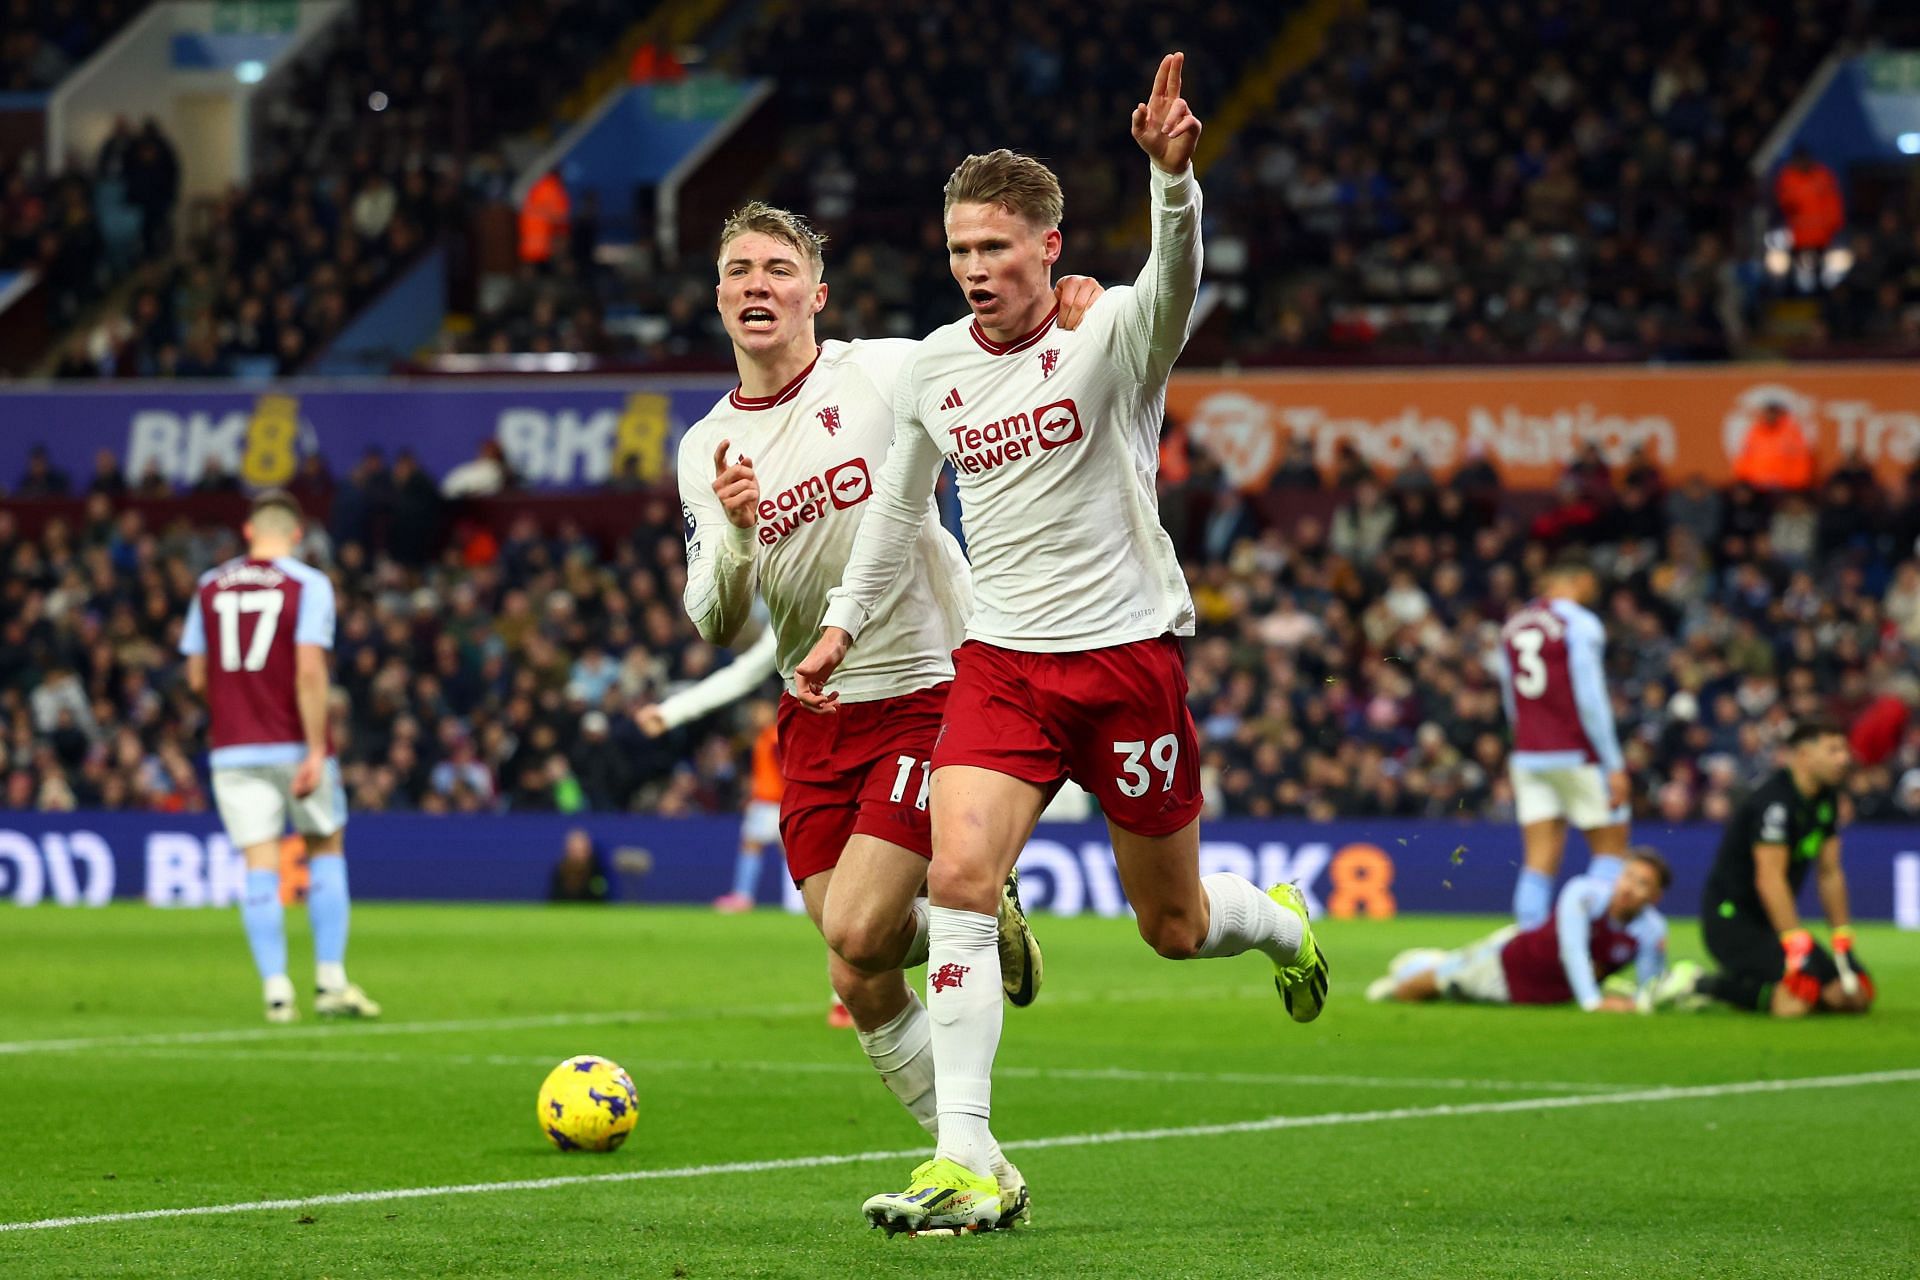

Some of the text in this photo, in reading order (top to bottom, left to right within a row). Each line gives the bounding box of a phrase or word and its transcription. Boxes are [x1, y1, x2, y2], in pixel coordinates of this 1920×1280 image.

[949, 412, 1031, 454] Team
[1282, 403, 1677, 470] Trade Nation
[757, 475, 825, 521] eam
[213, 589, 284, 671] 17
[1511, 628, 1548, 699] 3
[890, 755, 931, 811] 11
[1113, 733, 1178, 798] 39
